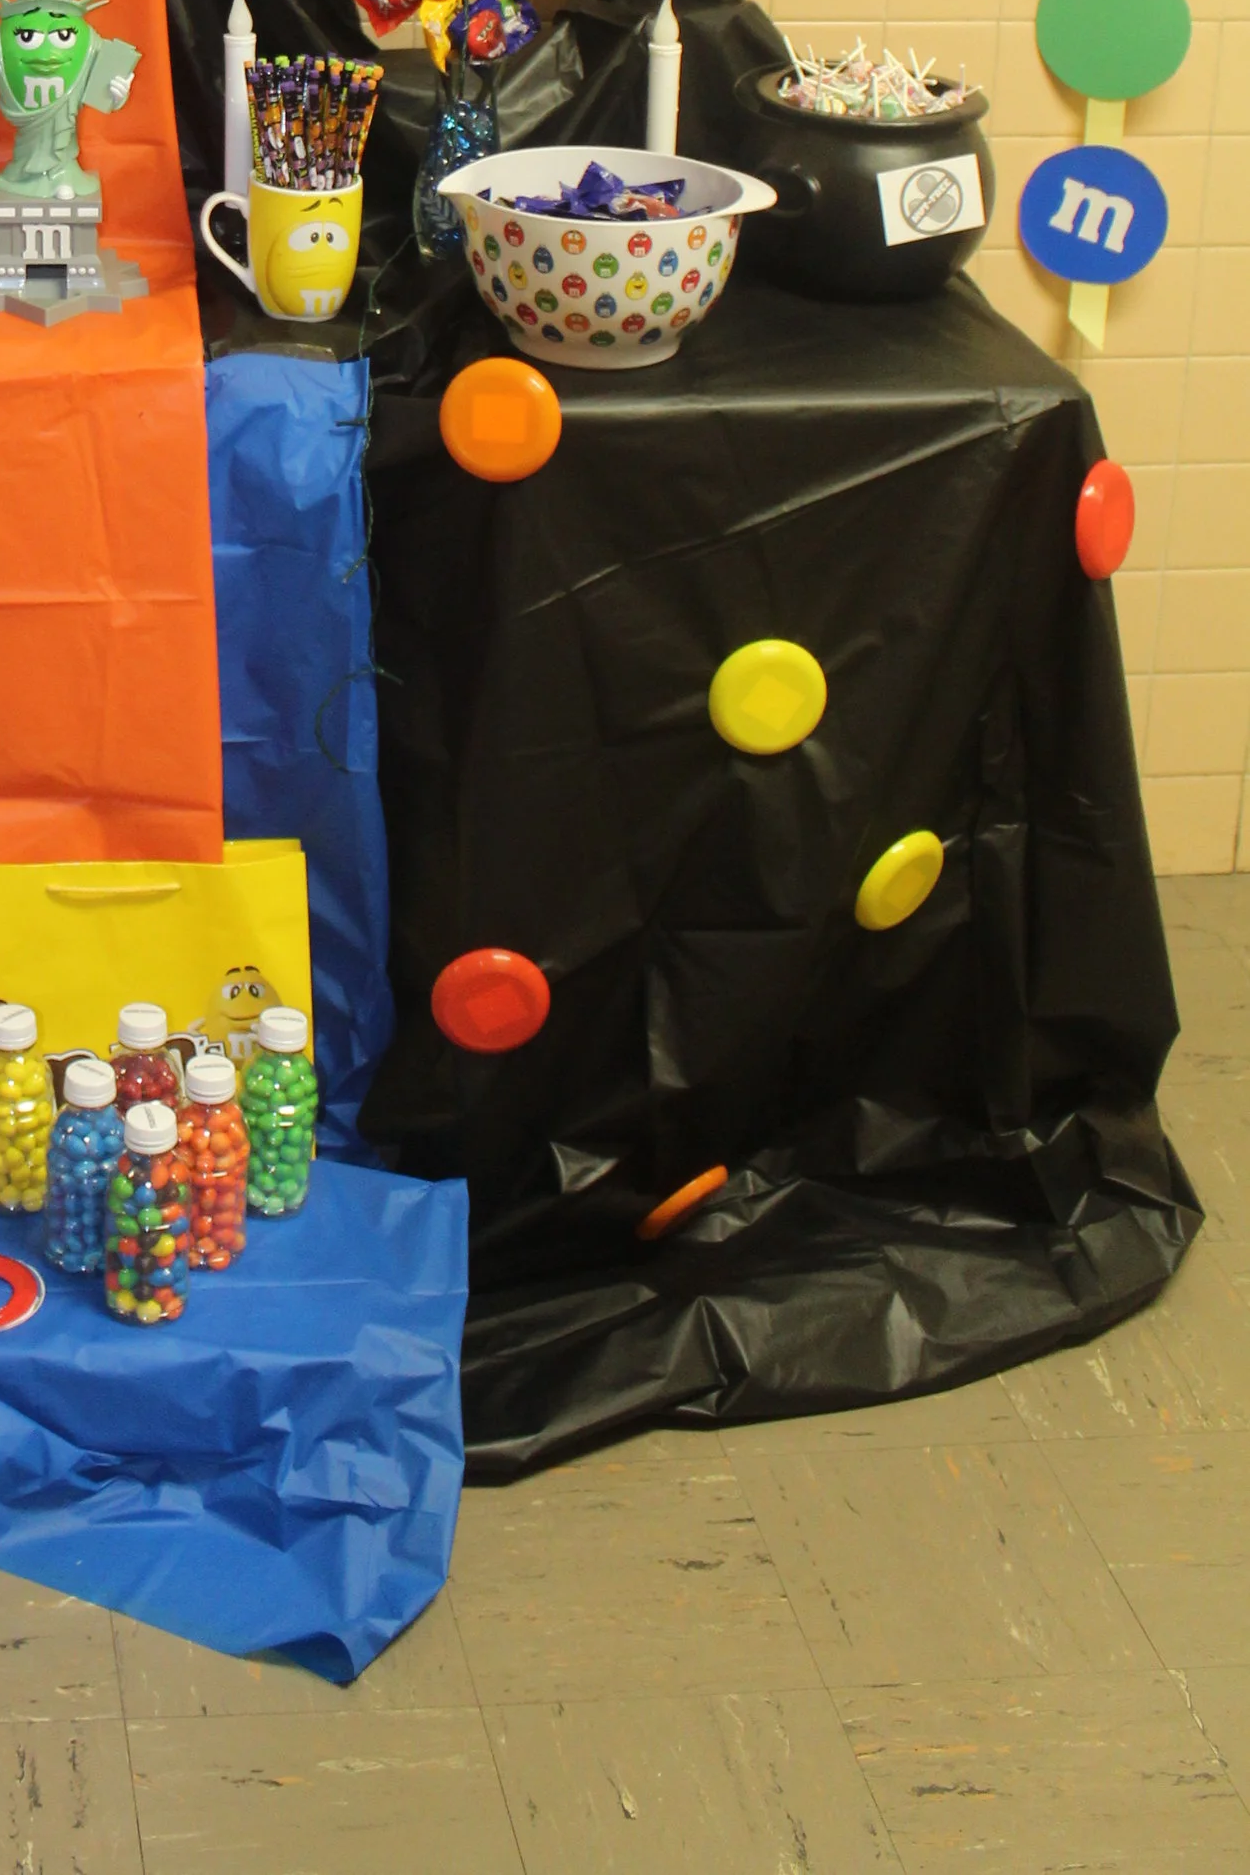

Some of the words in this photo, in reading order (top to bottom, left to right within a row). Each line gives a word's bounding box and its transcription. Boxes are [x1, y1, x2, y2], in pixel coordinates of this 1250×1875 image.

[24, 76, 64, 108] m
[1050, 177, 1134, 253] m
[22, 224, 72, 259] m
[301, 288, 343, 317] m
